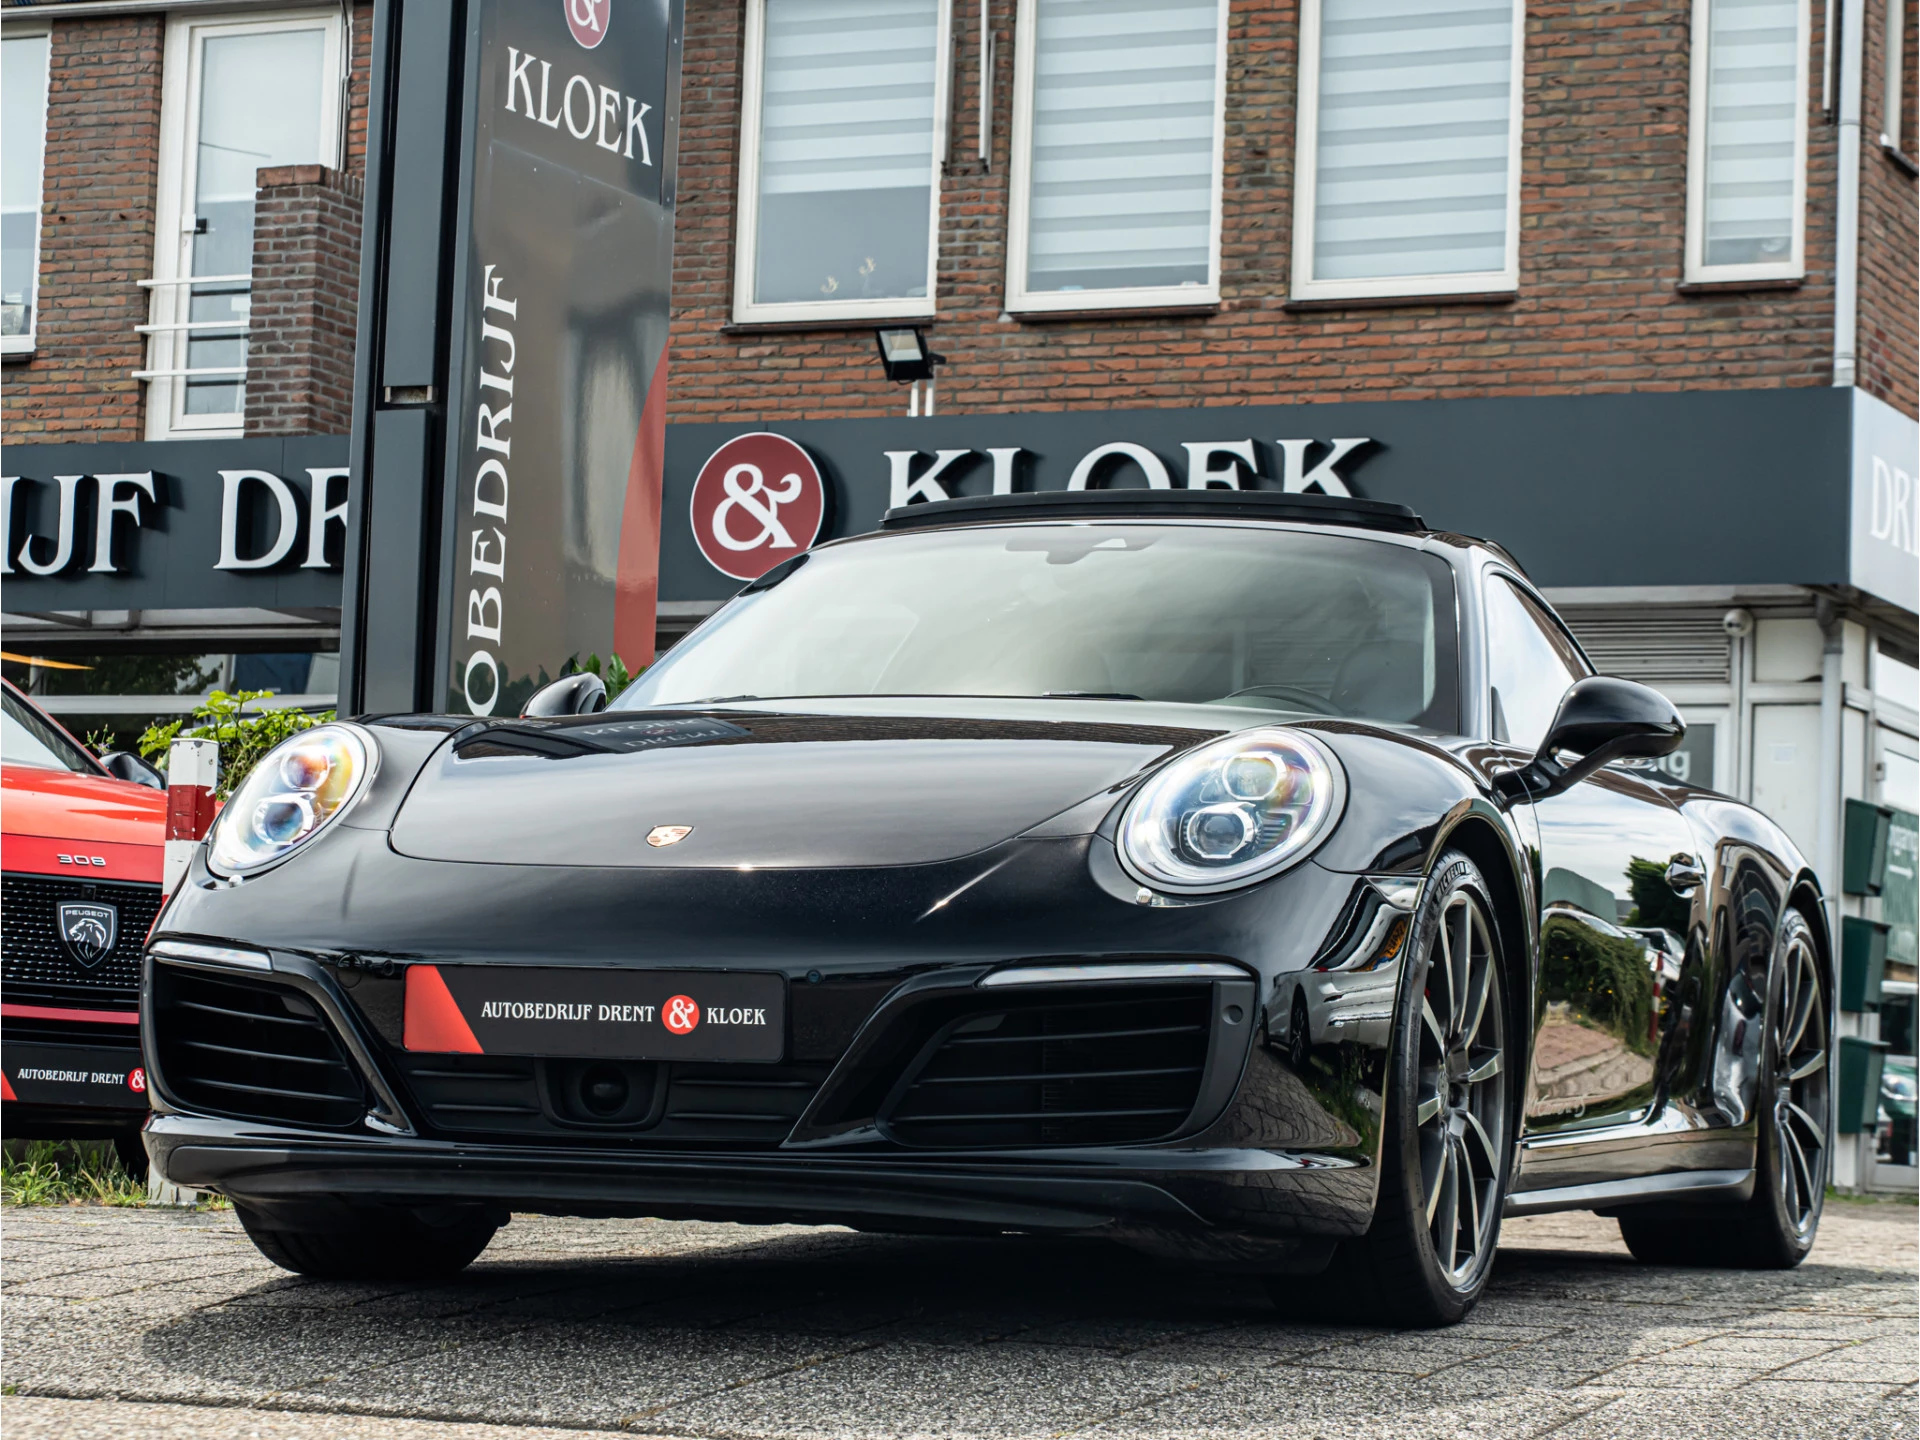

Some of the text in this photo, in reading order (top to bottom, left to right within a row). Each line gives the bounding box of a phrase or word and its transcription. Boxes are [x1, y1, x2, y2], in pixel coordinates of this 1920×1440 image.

[505, 46, 653, 167] KLOEK
[711, 463, 803, 552] &
[56, 853, 107, 867] 308
[1434, 860, 1467, 903] MICHELIN
[65, 909, 109, 919] PEUGEOT
[481, 998, 767, 1029] AUTOBEDRIJF DRENT & KLOEK
[17, 1068, 145, 1089] AUTOBEDRIJF DRENT &
